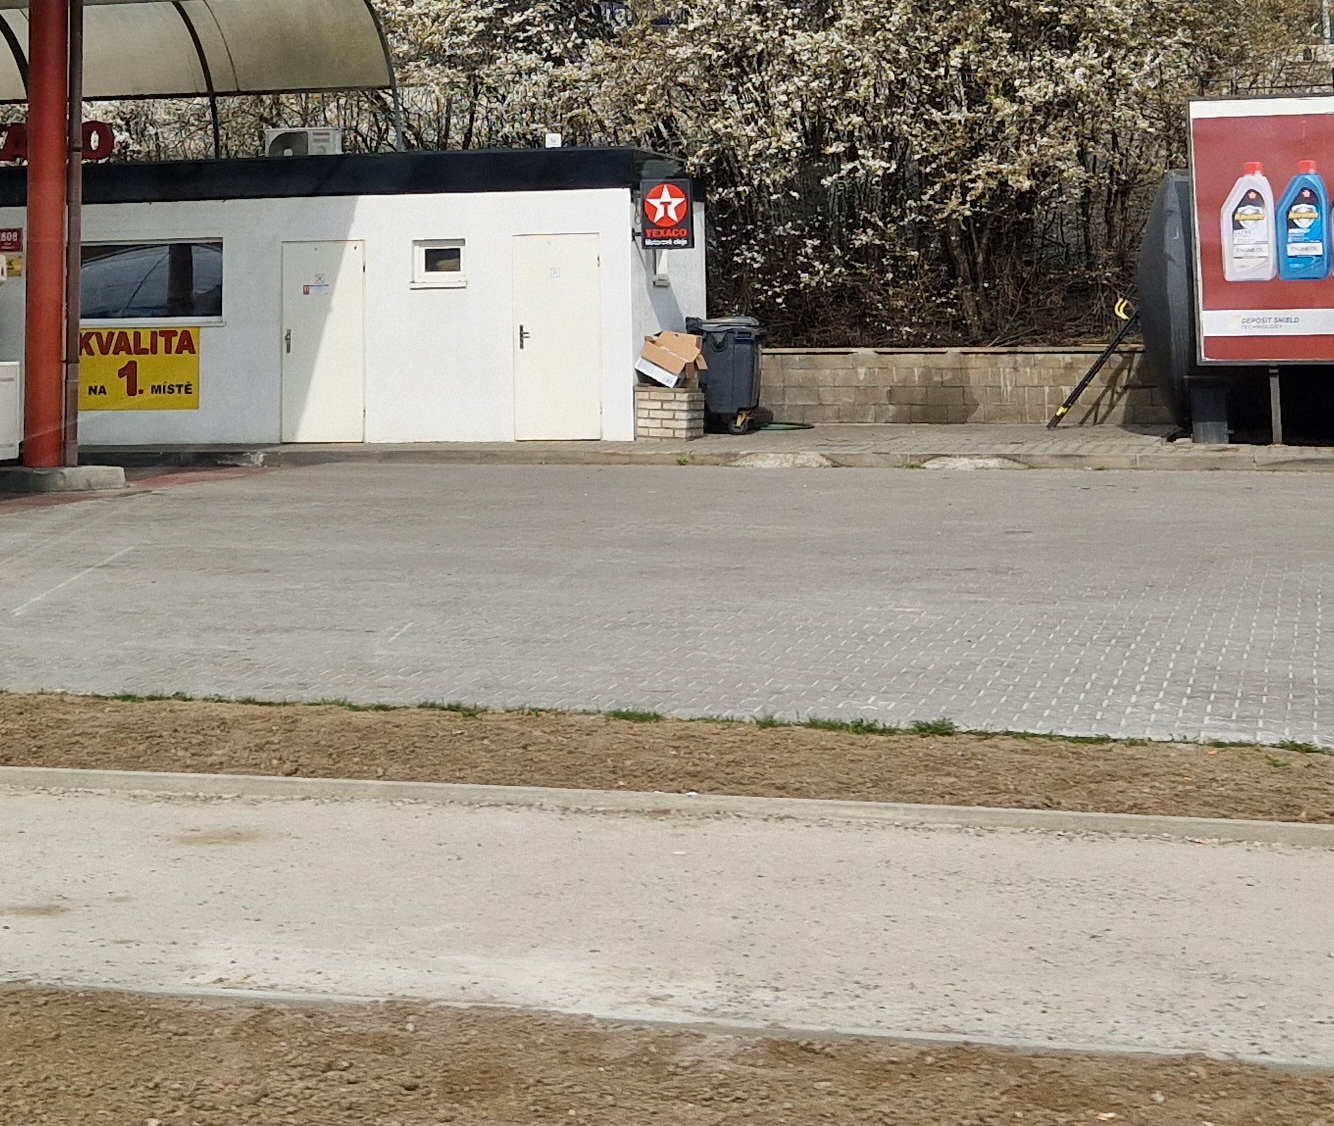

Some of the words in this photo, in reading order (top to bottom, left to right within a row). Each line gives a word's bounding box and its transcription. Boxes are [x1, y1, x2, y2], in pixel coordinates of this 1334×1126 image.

[644, 228, 688, 238] TEXACO
[79, 330, 196, 356] KVALITA
[88, 385, 107, 395] NA
[117, 360, 144, 396] 1.
[151, 381, 193, 395] MÍSTĚ
